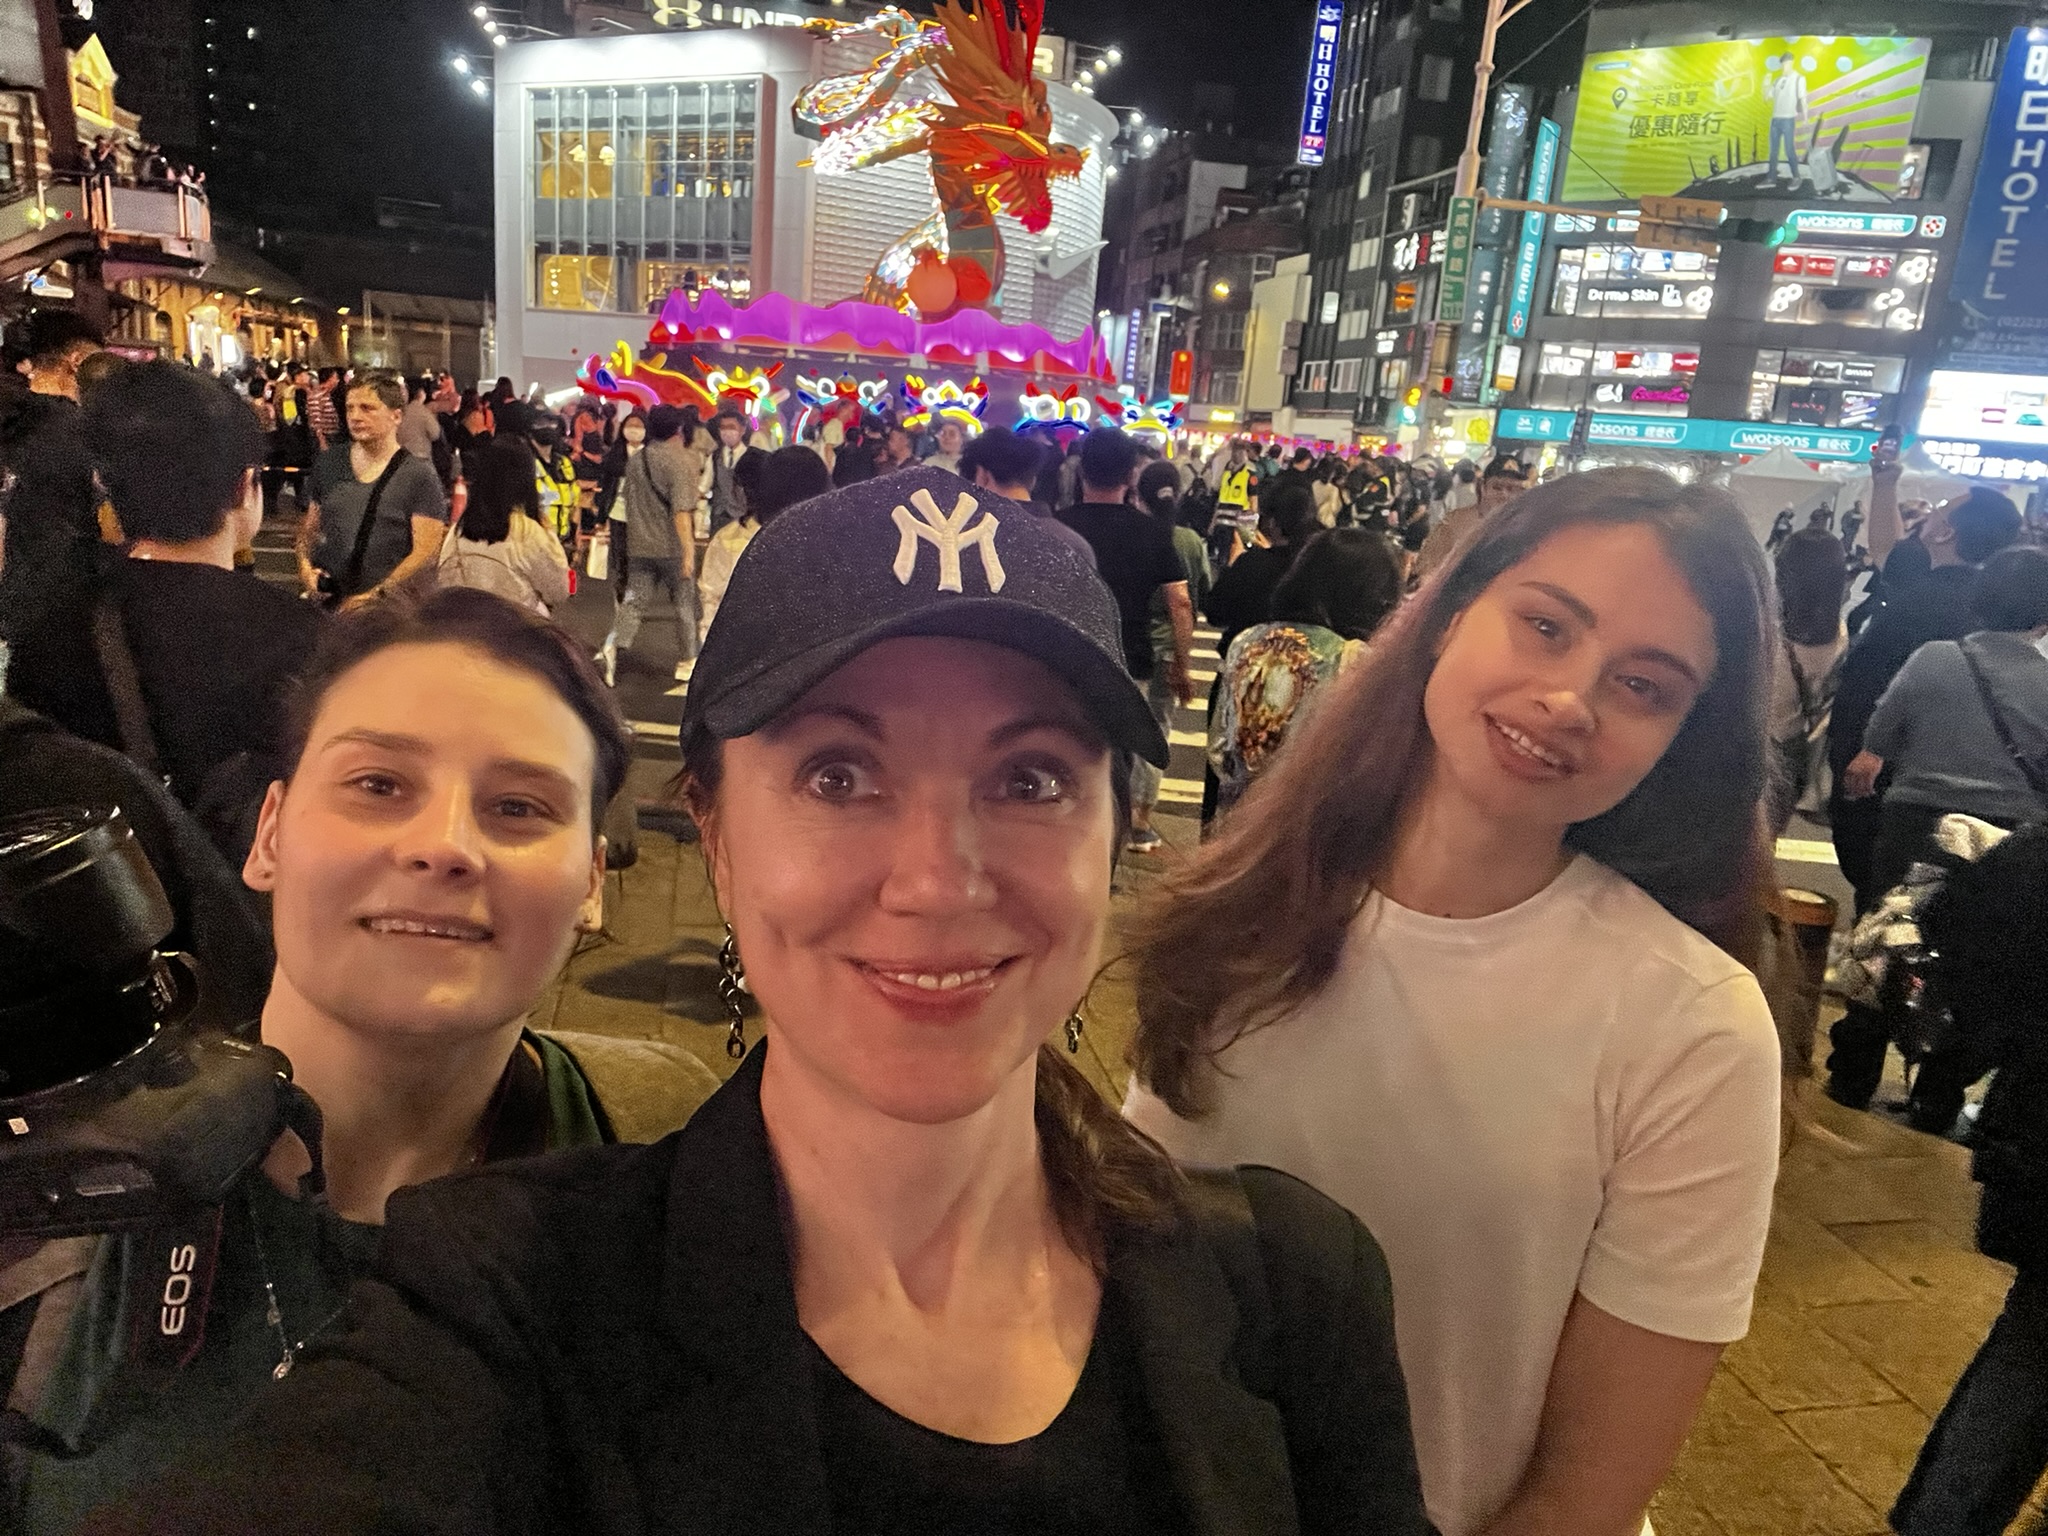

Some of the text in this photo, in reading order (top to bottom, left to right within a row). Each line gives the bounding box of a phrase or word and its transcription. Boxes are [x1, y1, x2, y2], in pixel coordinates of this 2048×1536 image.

[712, 4, 816, 29] UND
[1309, 63, 1332, 133] HOTEL
[1629, 111, 1727, 138] 優惠隨行
[1797, 216, 1865, 230] watsons
[1984, 139, 2046, 299] HOTEL
[1631, 289, 1659, 302] Skin
[1590, 421, 1639, 437] atsons
[1742, 432, 1810, 448] watsons
[1930, 453, 2048, 481] 門町遊客中
[161, 1244, 196, 1335] EOS
